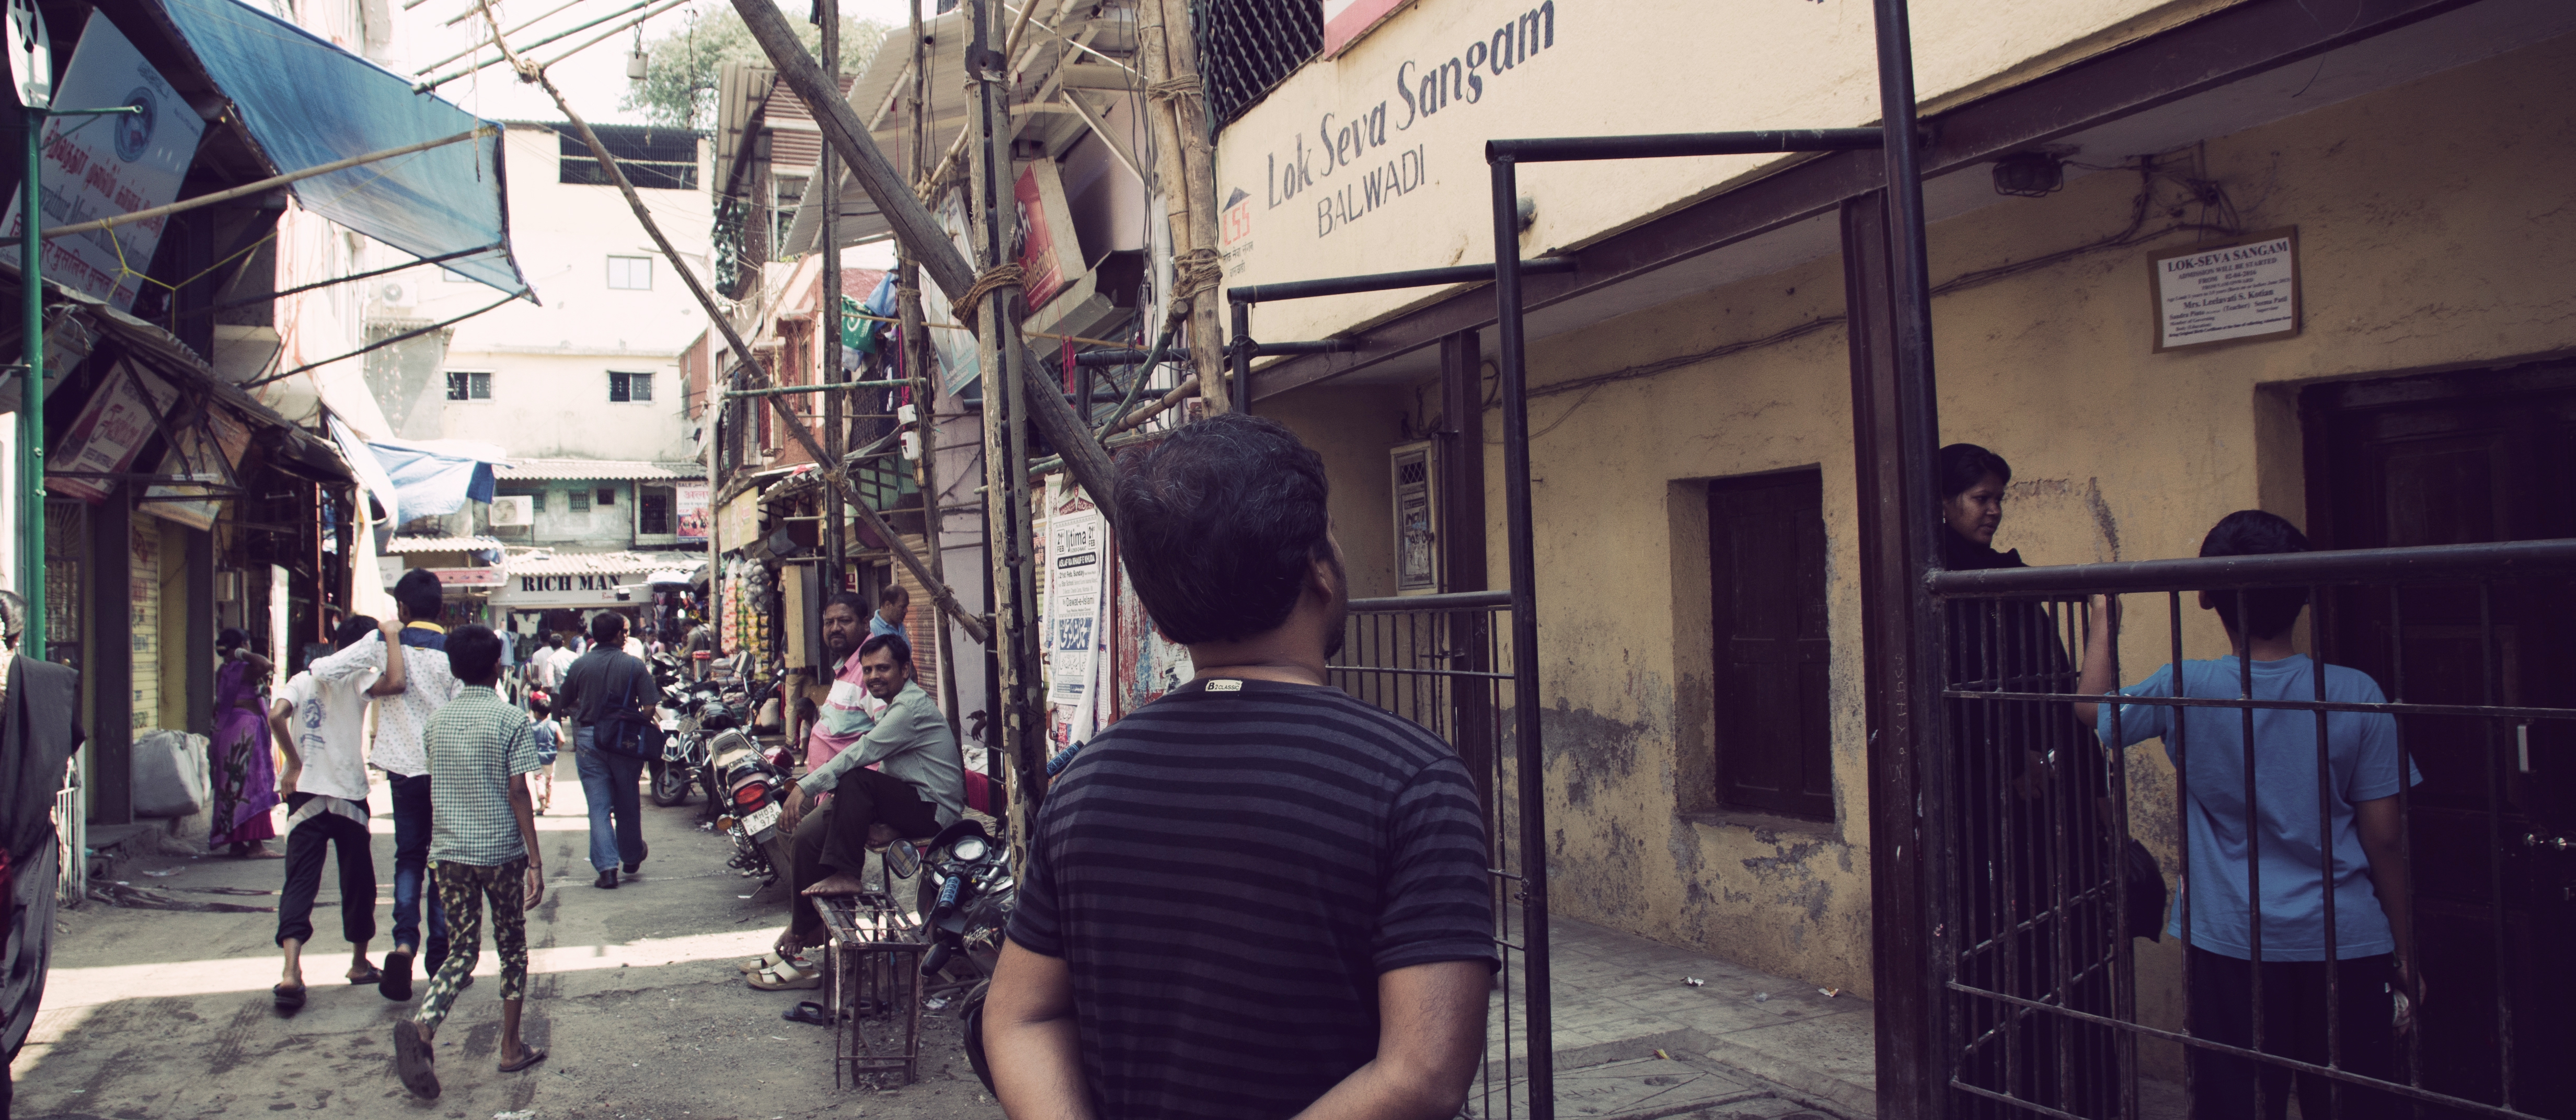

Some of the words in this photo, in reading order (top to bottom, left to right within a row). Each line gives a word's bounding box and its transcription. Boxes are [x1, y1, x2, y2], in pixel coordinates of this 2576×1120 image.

[1267, 132, 1314, 211] Lok
[1320, 100, 1386, 177] Seva
[1396, 0, 1555, 131] Sangam
[1317, 143, 1426, 239] BALWADI
[1223, 199, 1250, 247] LSS
[2168, 252, 2230, 272] LOK-SEVA
[2233, 241, 2288, 261] SANGAM
[2198, 276, 2218, 284] FROM
[2183, 301, 2201, 309] Mrs.
[2238, 292, 2246, 301] S.
[1066, 528, 1086, 552] Ijtima
[521, 575, 571, 592] RICH
[578, 574, 620, 591] MAN
[1073, 569, 1084, 577] Sunday
[753, 805, 774, 821] MH03
